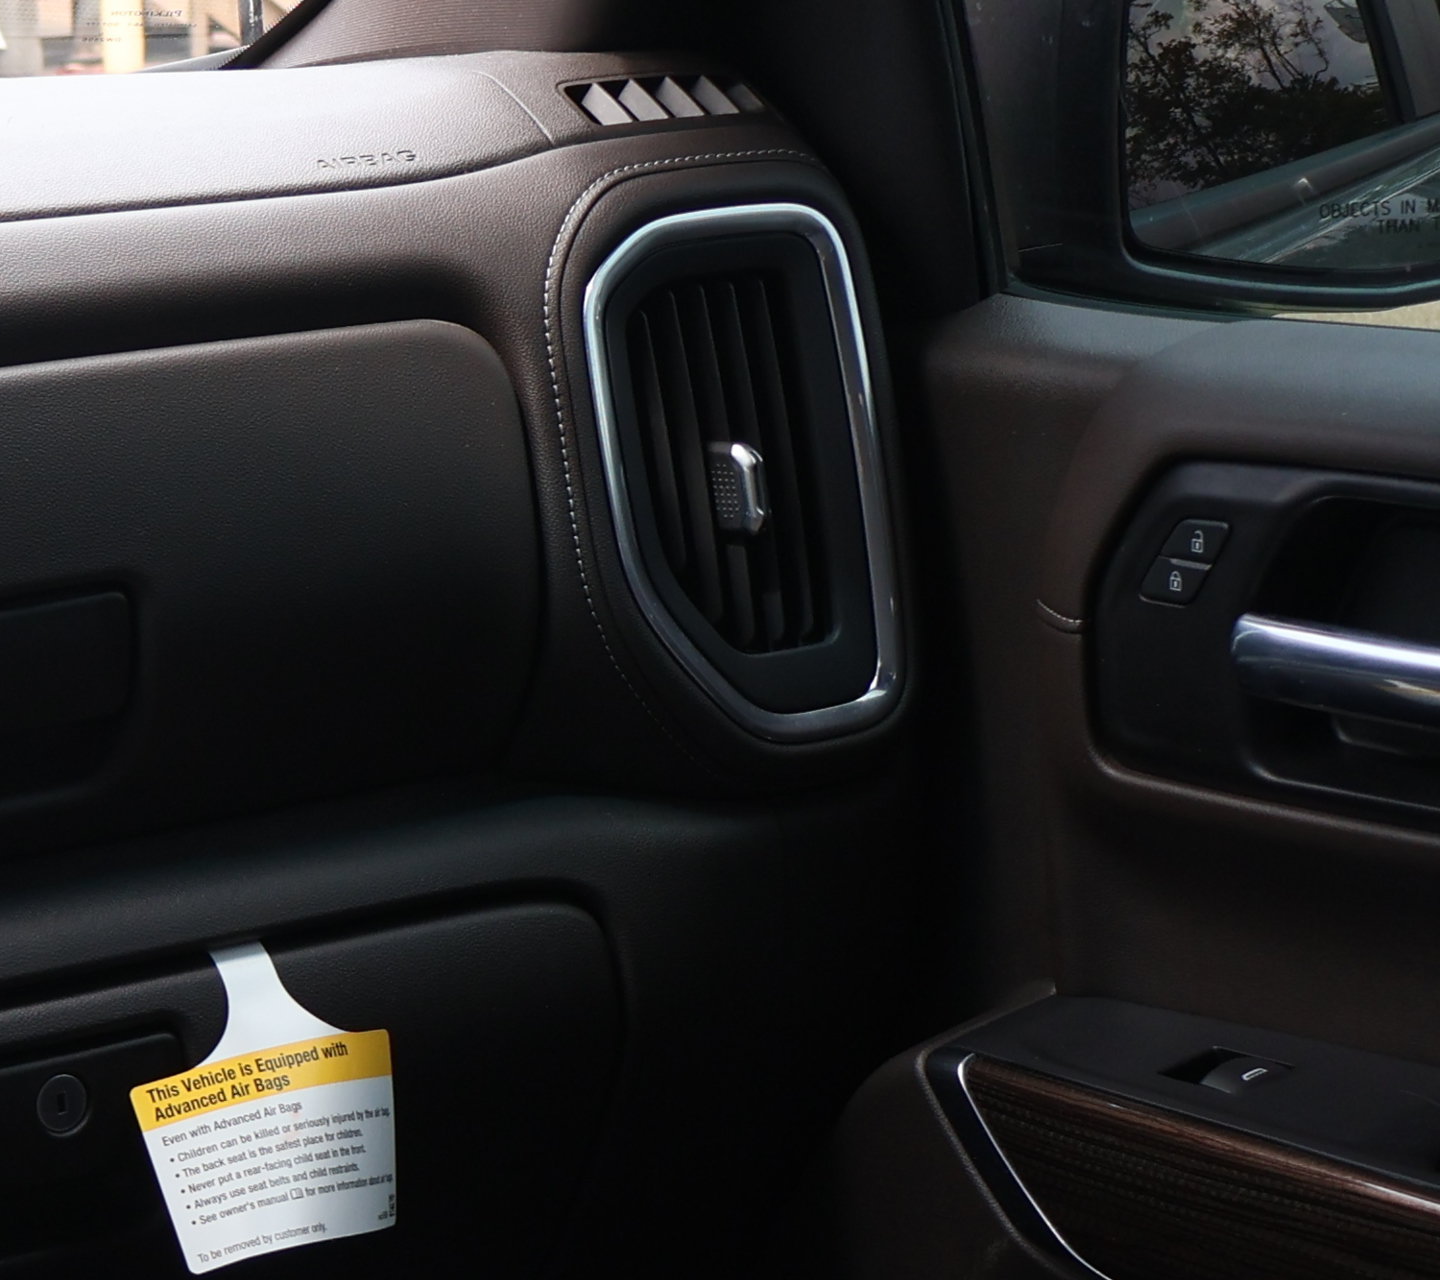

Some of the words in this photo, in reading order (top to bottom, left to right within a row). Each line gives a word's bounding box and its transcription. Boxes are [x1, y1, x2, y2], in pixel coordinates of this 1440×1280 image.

[317, 149, 419, 170] AIRBAG
[1320, 200, 1391, 220] OBJECTS
[1401, 199, 1416, 215] IN
[1377, 219, 1420, 234] THAN
[146, 1084, 180, 1103] This
[181, 1067, 236, 1092] Vehicle
[238, 1062, 253, 1076] is
[255, 1046, 319, 1073] Equipped
[322, 1042, 348, 1058] with
[155, 1088, 227, 1122] Advanced
[231, 1082, 251, 1099] Air
[253, 1074, 290, 1092] Bags
[162, 1132, 187, 1147] Even
[189, 1124, 212, 1138] with
[214, 1110, 262, 1131] Advanced
[264, 1106, 277, 1118] Air
[279, 1101, 302, 1115] Bags
[177, 1144, 218, 1162] Children
[220, 1138, 238, 1150] can
[240, 1134, 252, 1144] be
[253, 1126, 280, 1139] killed
[282, 1124, 291, 1133] or
[293, 1115, 330, 1132] seriously
[332, 1111, 356, 1124] injured
[182, 1166, 201, 1178] The
[202, 1158, 225, 1172] back
[227, 1152, 248, 1164] seat
[248, 1149, 257, 1158] is
[259, 1146, 273, 1156] the
[275, 1140, 301, 1152] safest
[302, 1136, 324, 1147] place
[324, 1132, 335, 1142] for
[188, 1179, 216, 1193] Never
[218, 1173, 234, 1186] put
[235, 1171, 242, 1179] a
[243, 1156, 293, 1177] rear-facing
[293, 1152, 313, 1165] child
[314, 1149, 331, 1160] seat
[331, 1148, 339, 1158] in
[339, 1147, 350, 1156] the
[194, 1192, 228, 1209] Always
[229, 1187, 246, 1198] use
[248, 1181, 268, 1193] seat
[269, 1175, 291, 1187] belts
[292, 1171, 308, 1182] and
[309, 1167, 328, 1179] child
[199, 1213, 218, 1225] See
[219, 1201, 256, 1218] owner's
[257, 1192, 288, 1208] manual
[304, 1187, 316, 1197] for
[318, 1184, 336, 1194] more
[197, 1252, 209, 1263] To
[210, 1249, 222, 1260] be
[224, 1236, 261, 1255] removed
[261, 1234, 273, 1245] by
[274, 1225, 310, 1240] customer
